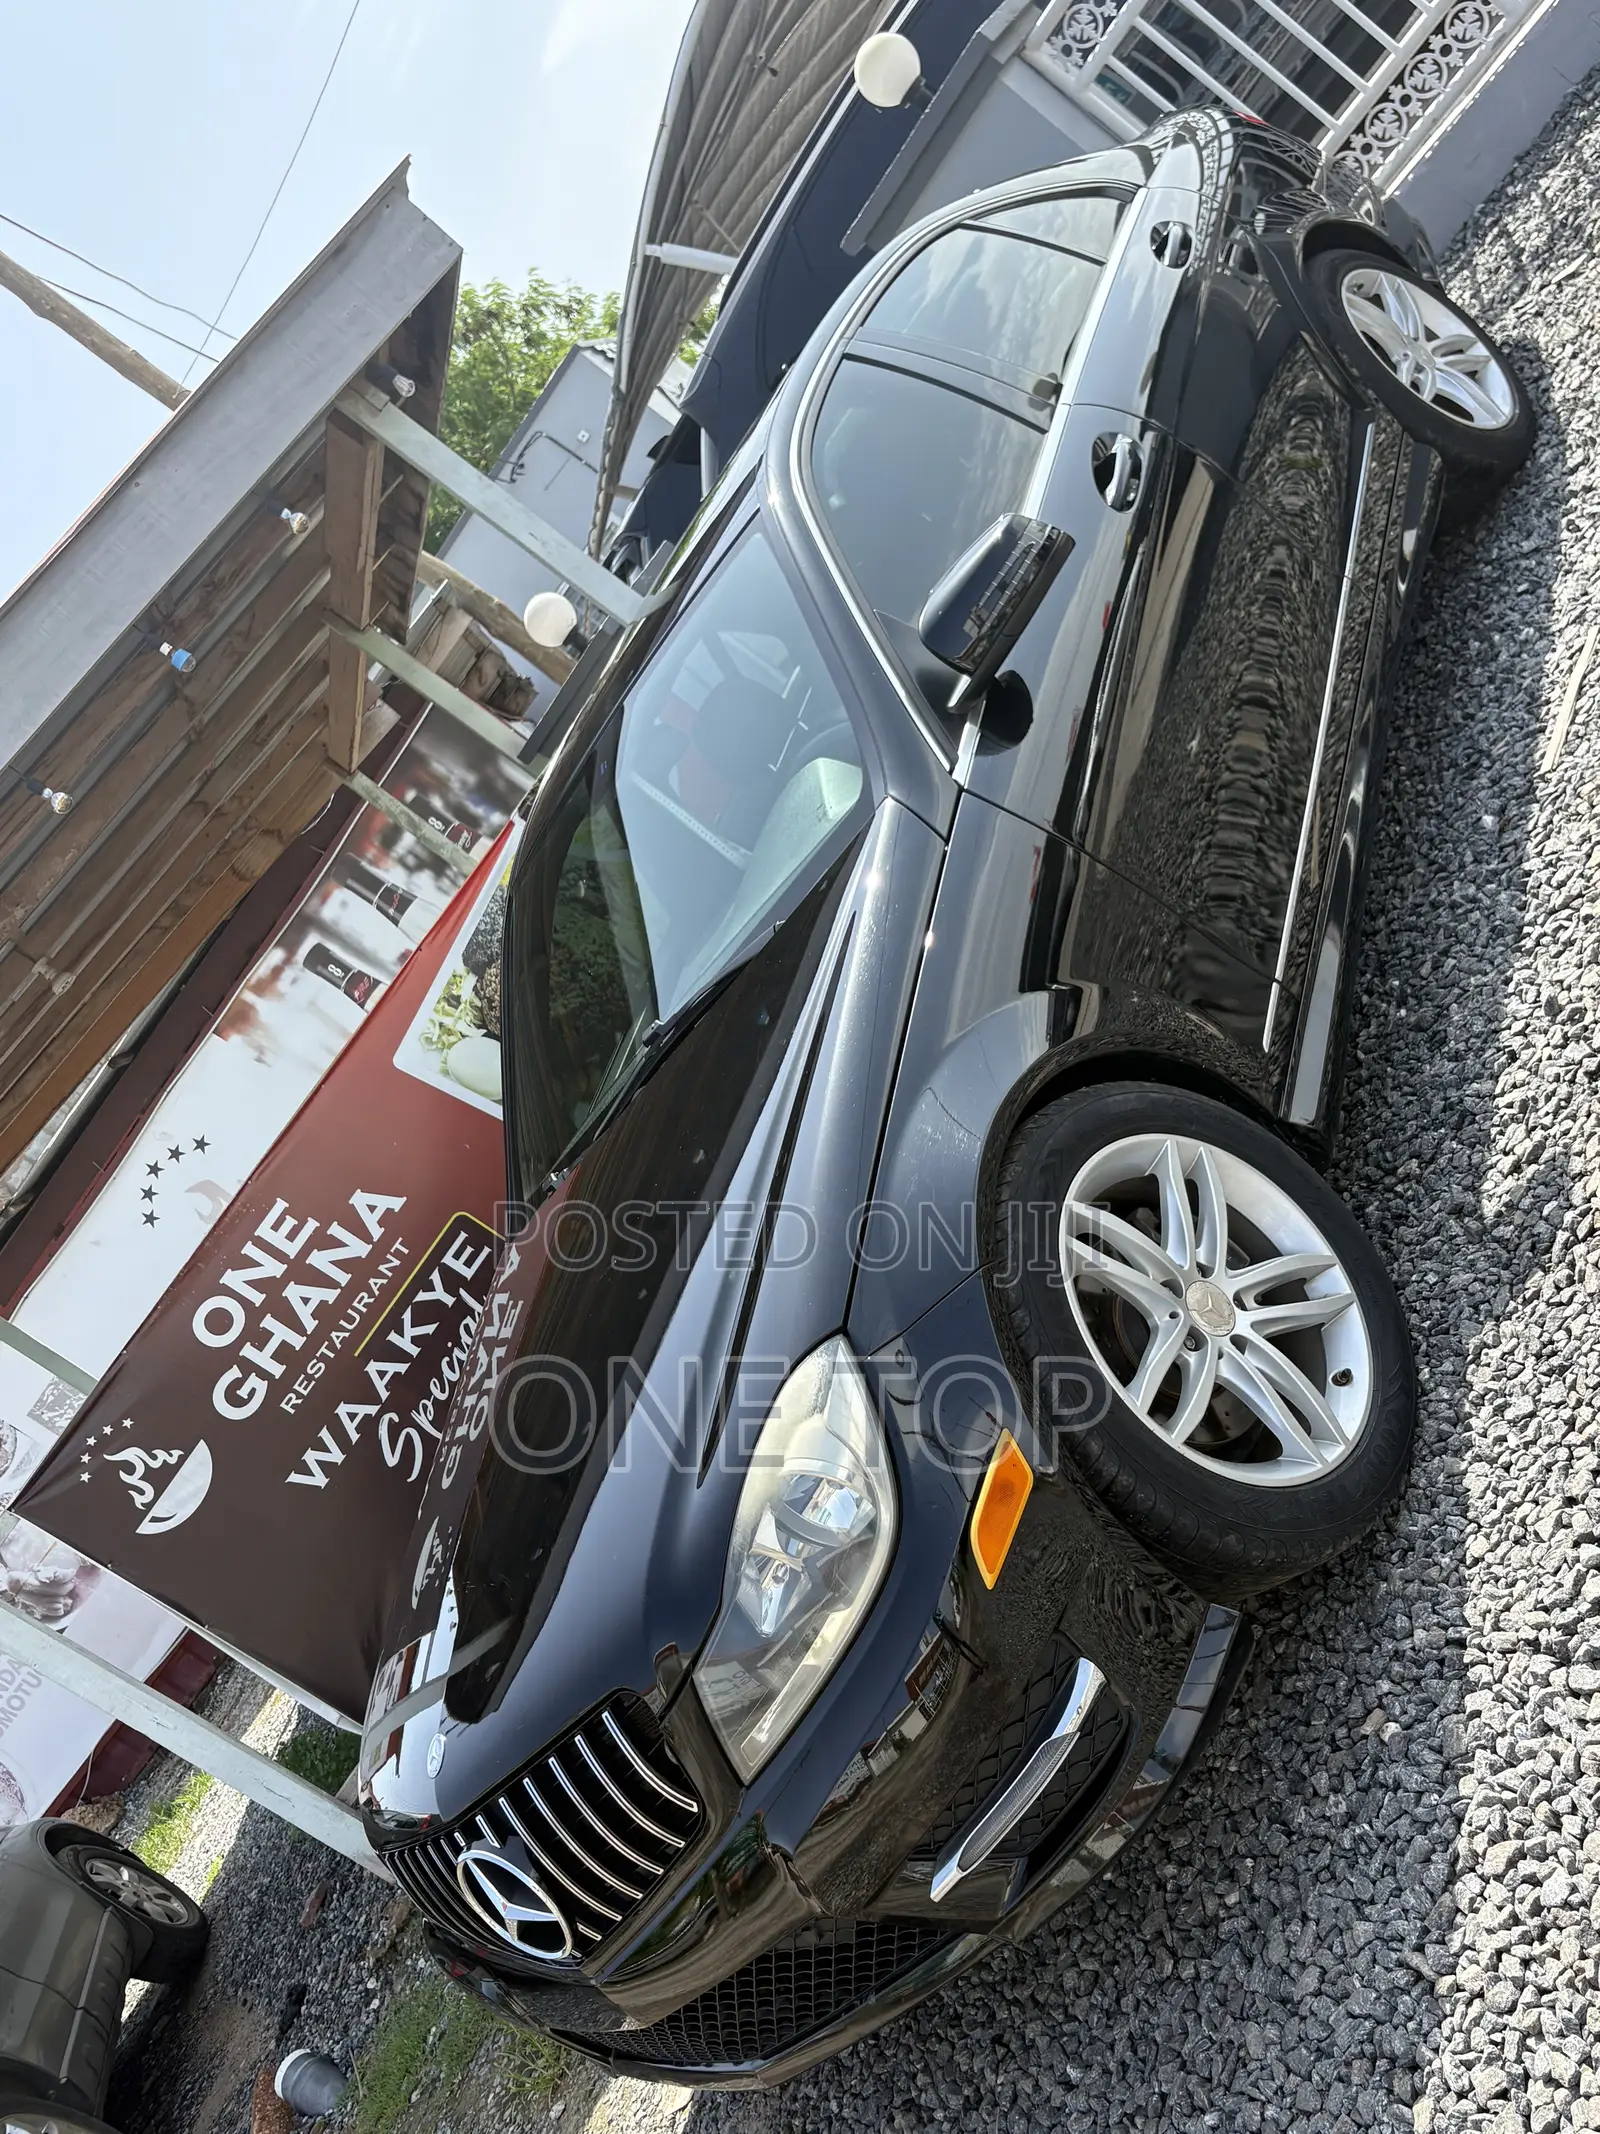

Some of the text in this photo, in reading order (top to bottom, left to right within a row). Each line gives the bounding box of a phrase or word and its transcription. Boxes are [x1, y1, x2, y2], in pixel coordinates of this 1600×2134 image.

[328, 963, 343, 977] 8
[193, 1198, 320, 1347] ONE
[213, 1189, 407, 1420] GHANA
[280, 1237, 409, 1414] RESTAURANT
[285, 1231, 491, 1489] WAAKYE
[379, 1287, 486, 1482] Special
